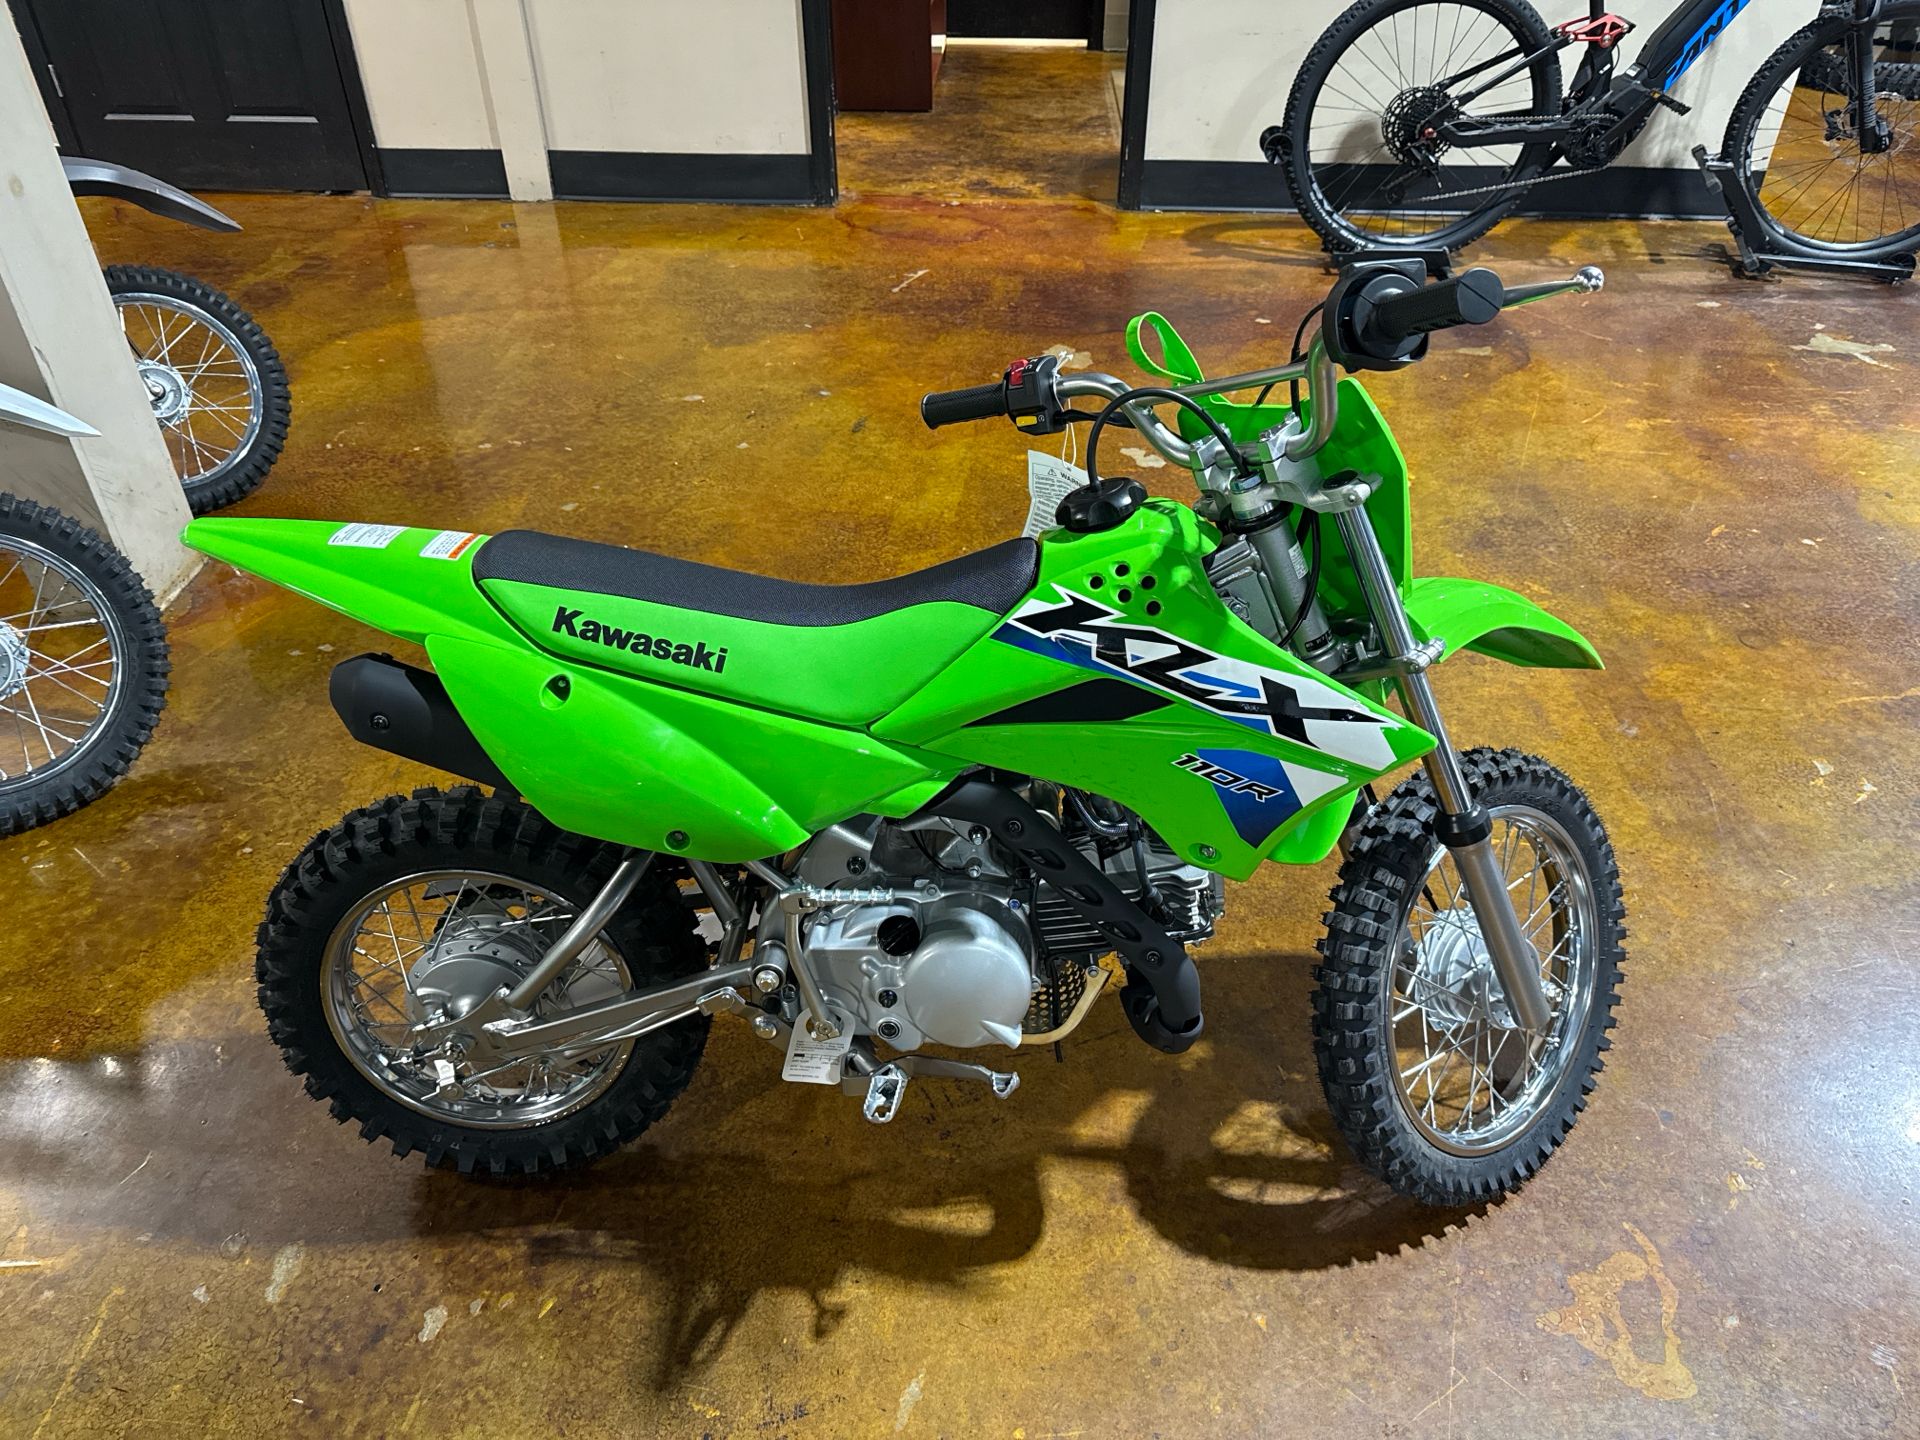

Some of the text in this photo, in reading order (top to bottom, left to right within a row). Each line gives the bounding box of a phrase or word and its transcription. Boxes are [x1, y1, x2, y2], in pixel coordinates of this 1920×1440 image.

[1060, 471, 1082, 487] WARN
[552, 606, 728, 674] Kawasaki
[1172, 753, 1284, 803] 110R
